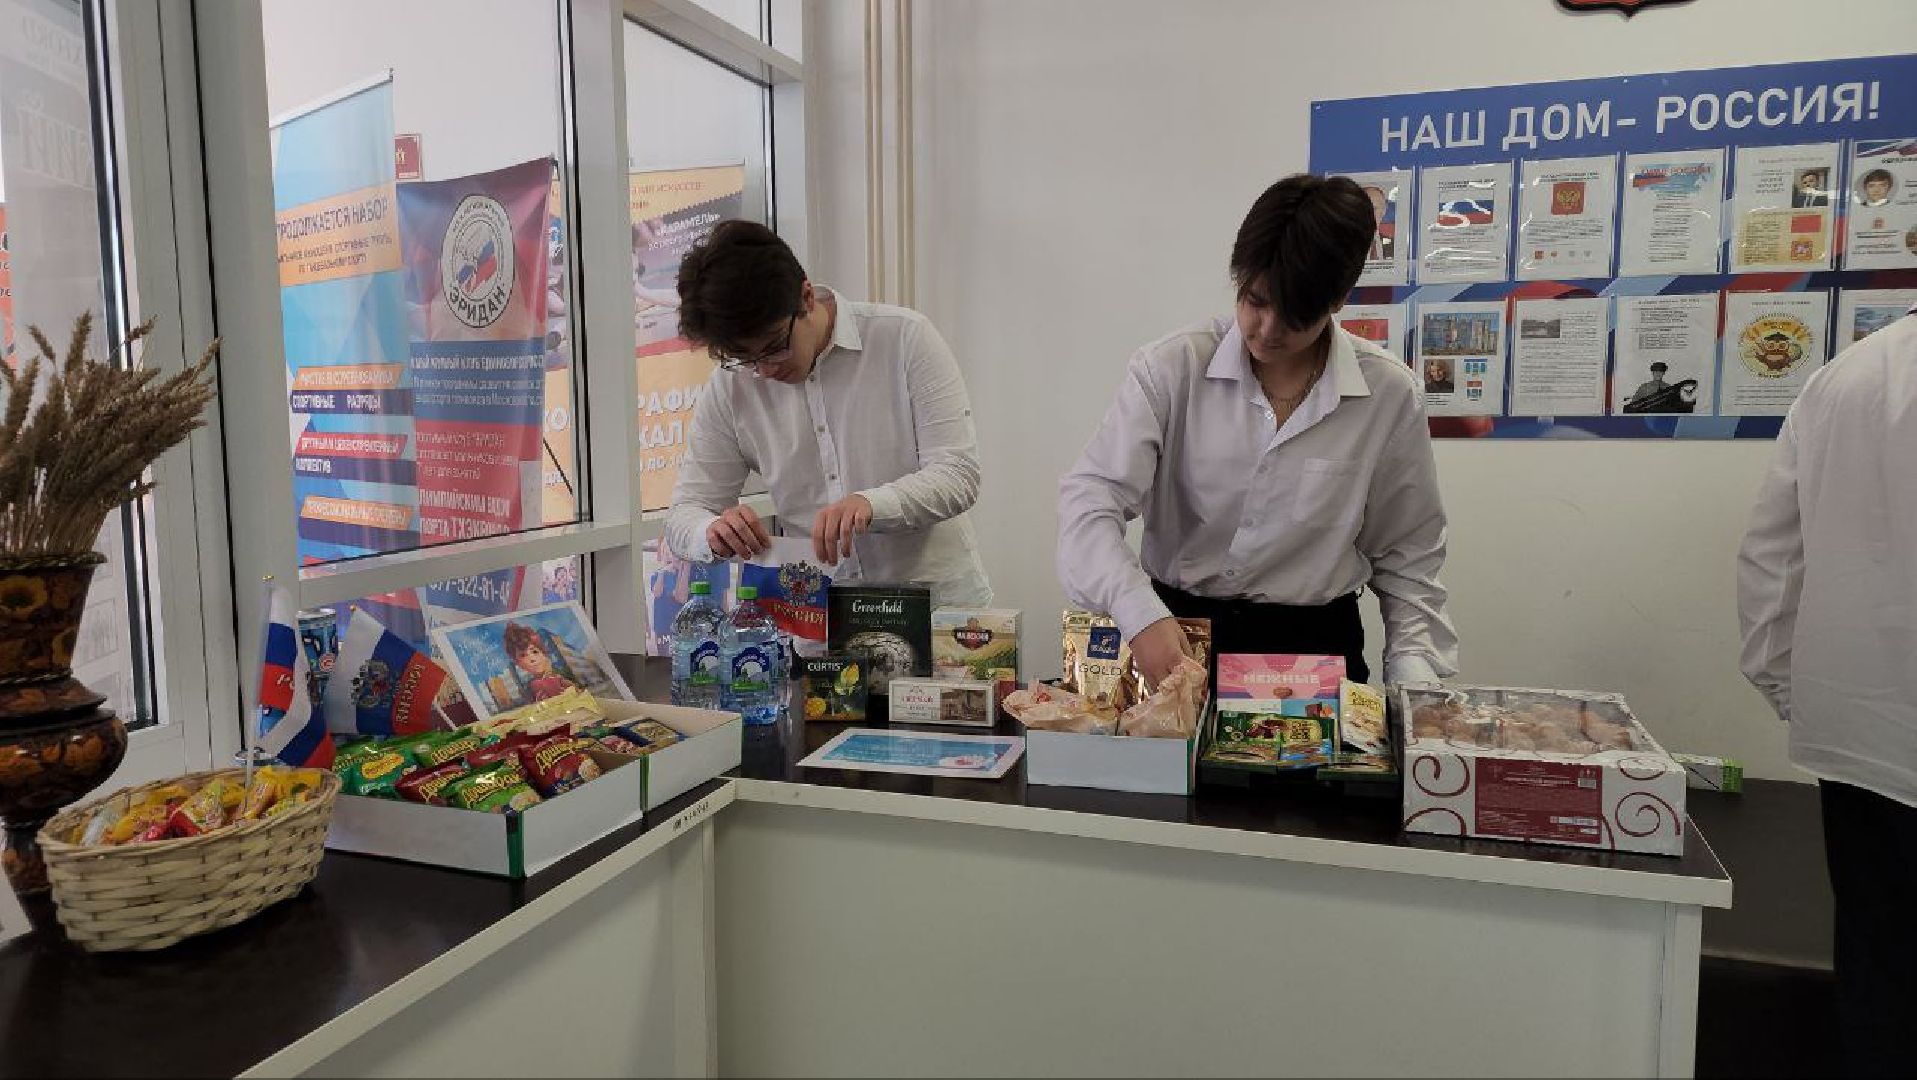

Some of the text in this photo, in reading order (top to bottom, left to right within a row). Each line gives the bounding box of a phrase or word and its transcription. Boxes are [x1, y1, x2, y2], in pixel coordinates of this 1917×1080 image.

[1380, 108, 1487, 153] НАШ
[1654, 80, 1881, 134] РОССИЯ!
[448, 284, 506, 327] ЭРИДАН
[851, 599, 904, 616] Greenfield
[807, 662, 843, 672] CURTIS
[1079, 664, 1123, 676] GOLD
